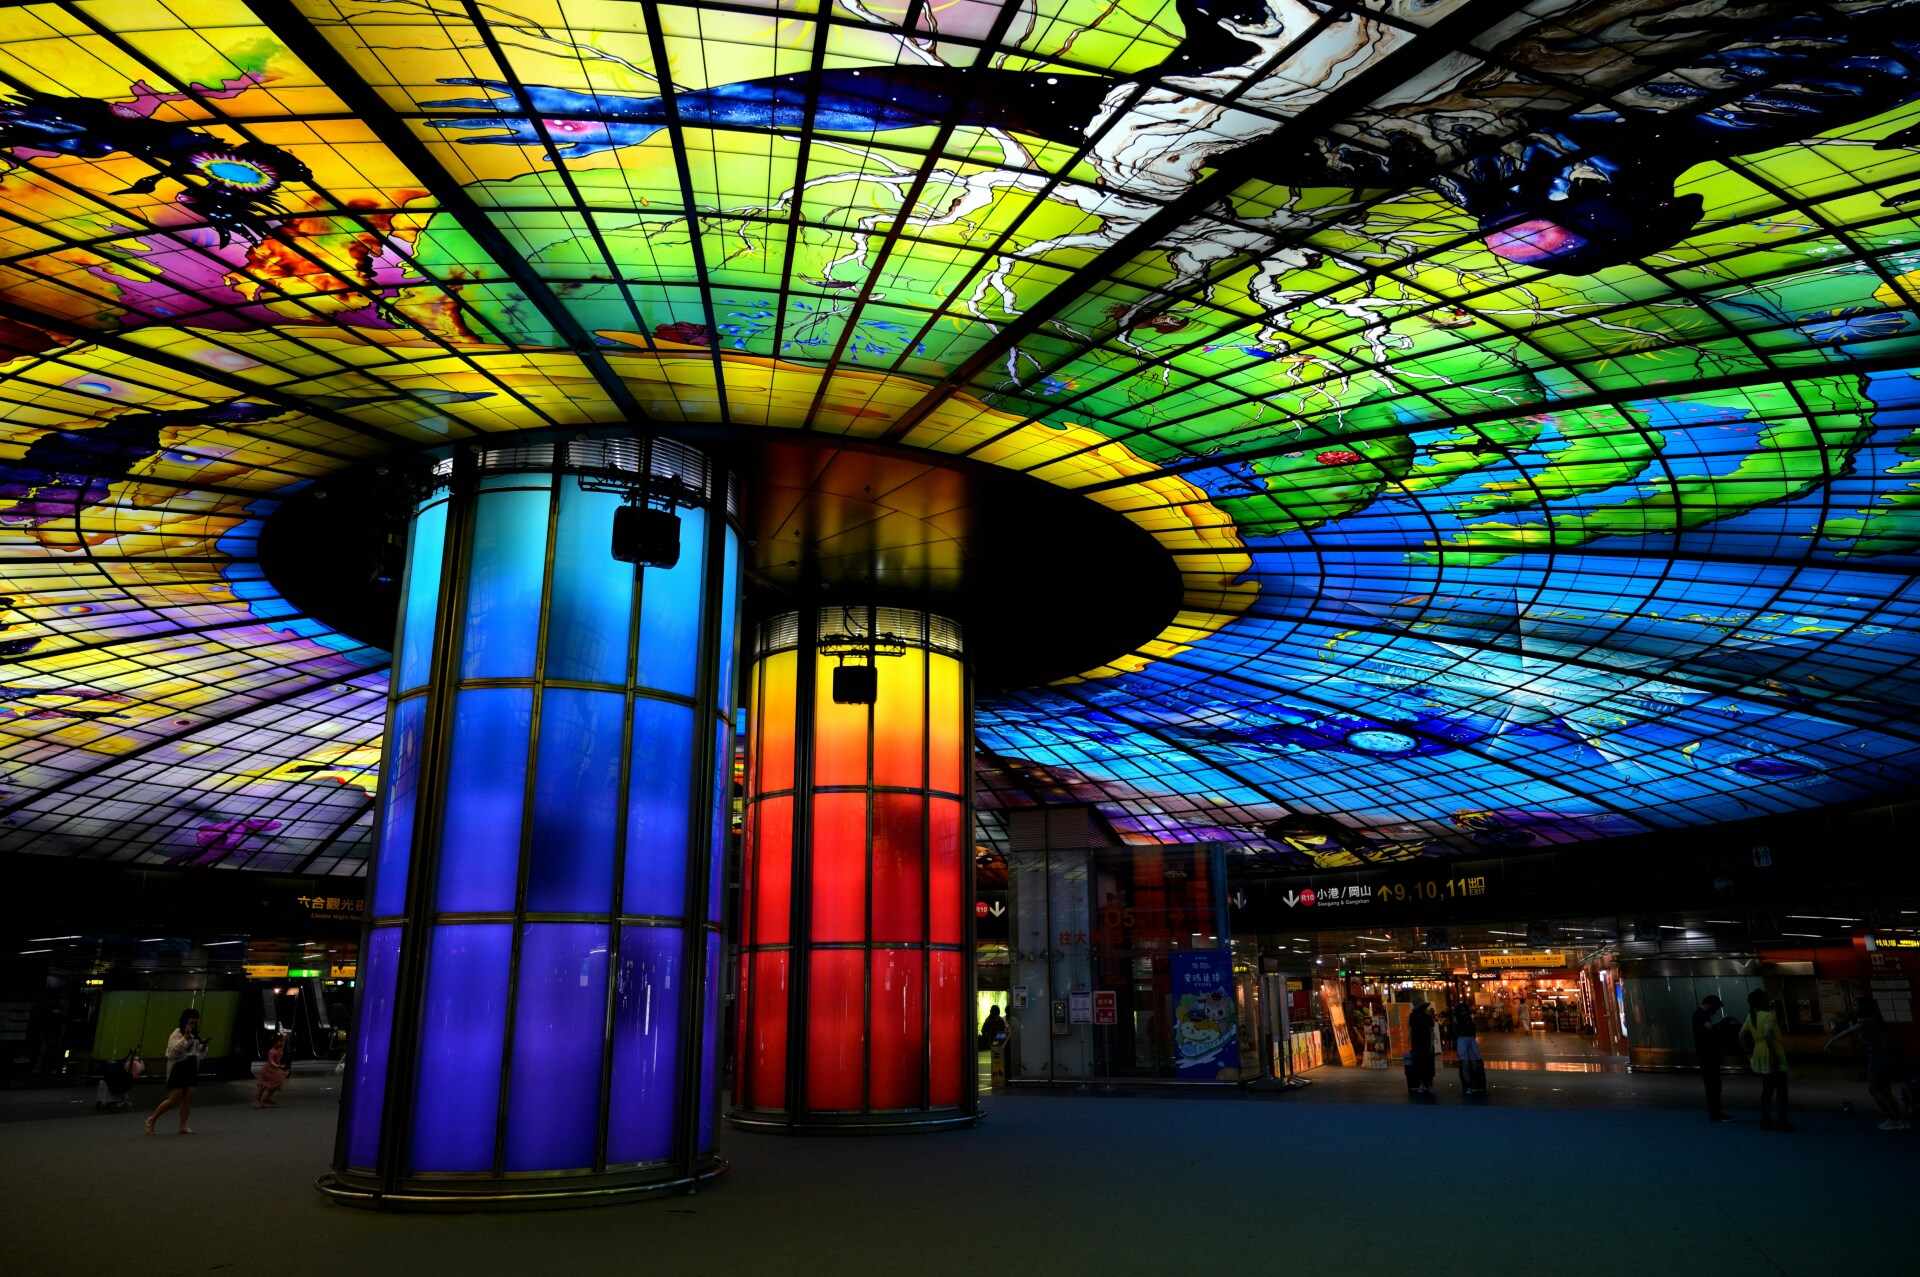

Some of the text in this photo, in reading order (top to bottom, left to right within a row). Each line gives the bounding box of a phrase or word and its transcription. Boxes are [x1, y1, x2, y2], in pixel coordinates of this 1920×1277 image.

[1467, 876, 1485, 888] 出口
[1469, 887, 1485, 896] EXIT
[1301, 894, 1315, 902] R10
